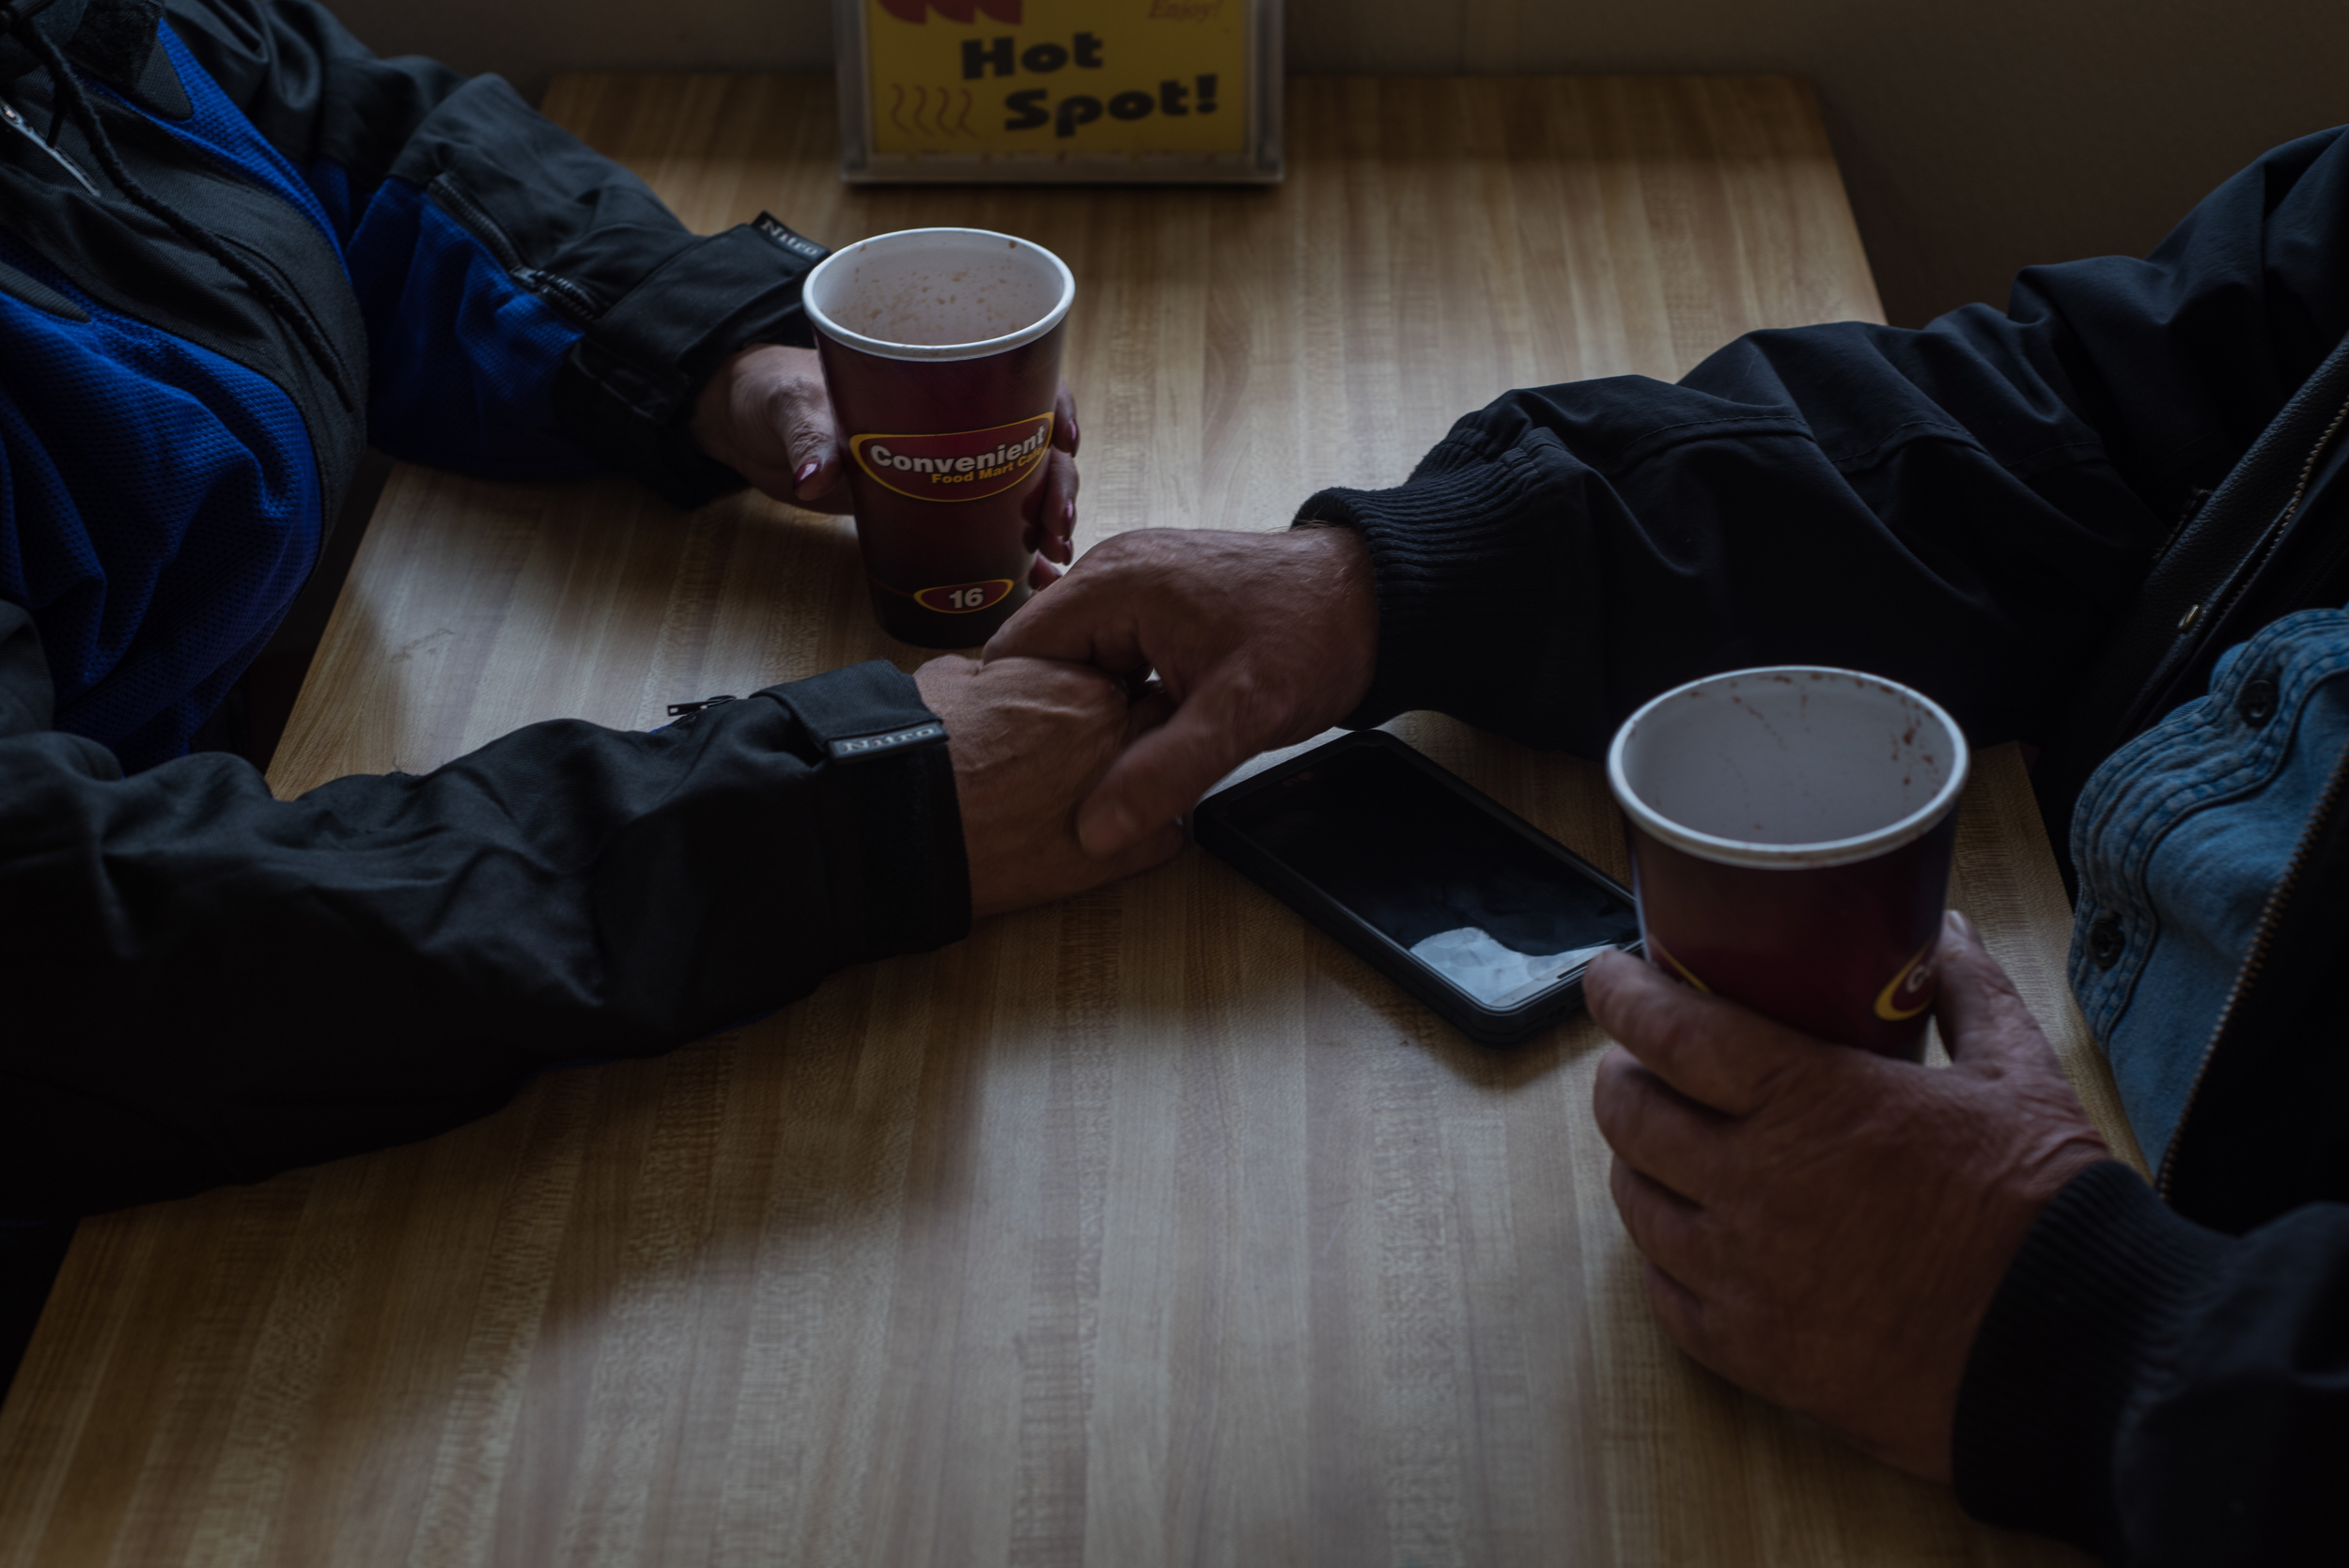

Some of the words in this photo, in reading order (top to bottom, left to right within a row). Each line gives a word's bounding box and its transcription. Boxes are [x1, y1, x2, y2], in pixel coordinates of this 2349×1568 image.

[961, 32, 1103, 80] Hot
[1004, 74, 1219, 138] Spot!
[759, 218, 818, 256] Nitro
[869, 425, 1046, 474] Convenient
[931, 471, 974, 484] Food
[979, 461, 1014, 480] Mart
[948, 587, 985, 610] 16
[842, 727, 935, 753] Nitro
